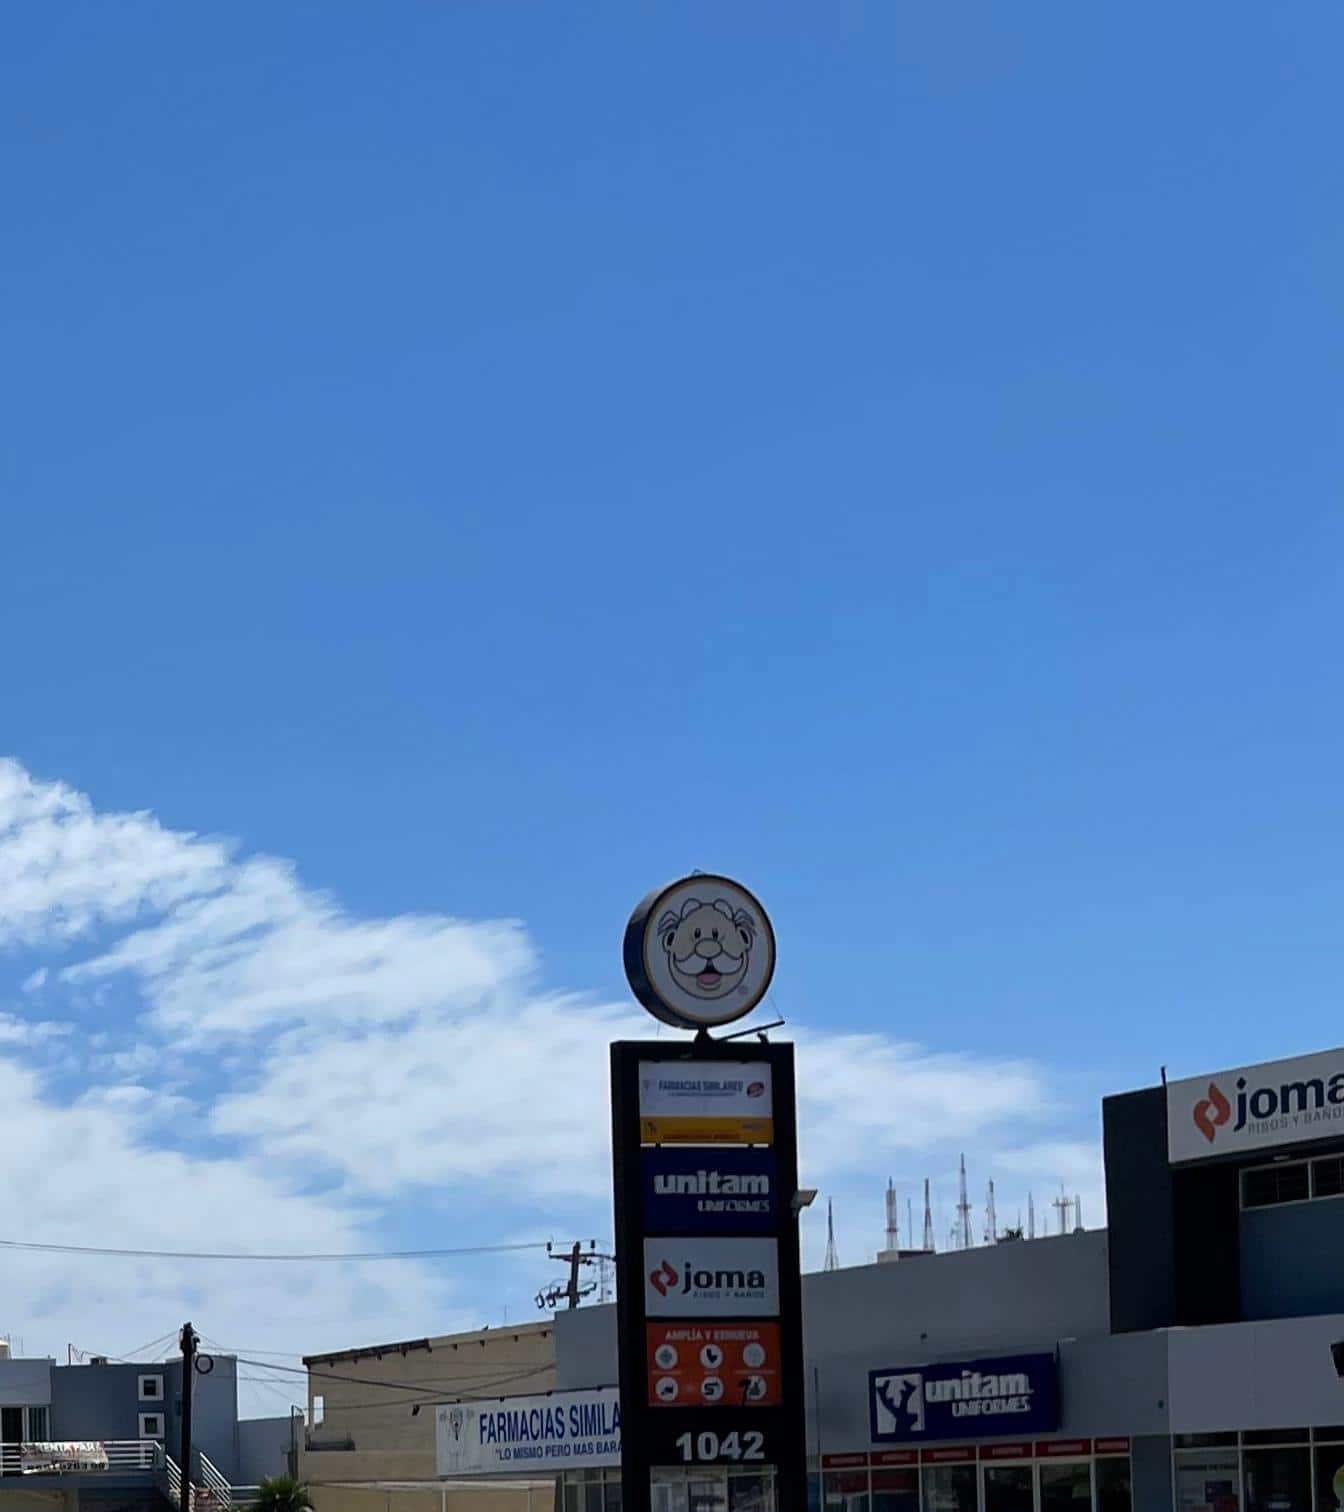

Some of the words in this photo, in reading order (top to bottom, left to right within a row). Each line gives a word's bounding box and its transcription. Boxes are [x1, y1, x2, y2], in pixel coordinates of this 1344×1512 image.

[1233, 1073, 1344, 1132] joma
[1304, 1105, 1344, 1124] BAÑO
[654, 1170, 769, 1194] unitam
[682, 1262, 765, 1295] joma
[704, 1330, 712, 1341] Y
[925, 1370, 1031, 1402] unitam
[952, 1396, 1032, 1417] UNIFORMES
[479, 1407, 566, 1445] FARMACIAS
[513, 1446, 544, 1460] MISMO
[545, 1444, 571, 1457] PERO
[574, 1442, 594, 1455] MAS
[676, 1431, 765, 1460] 1042
